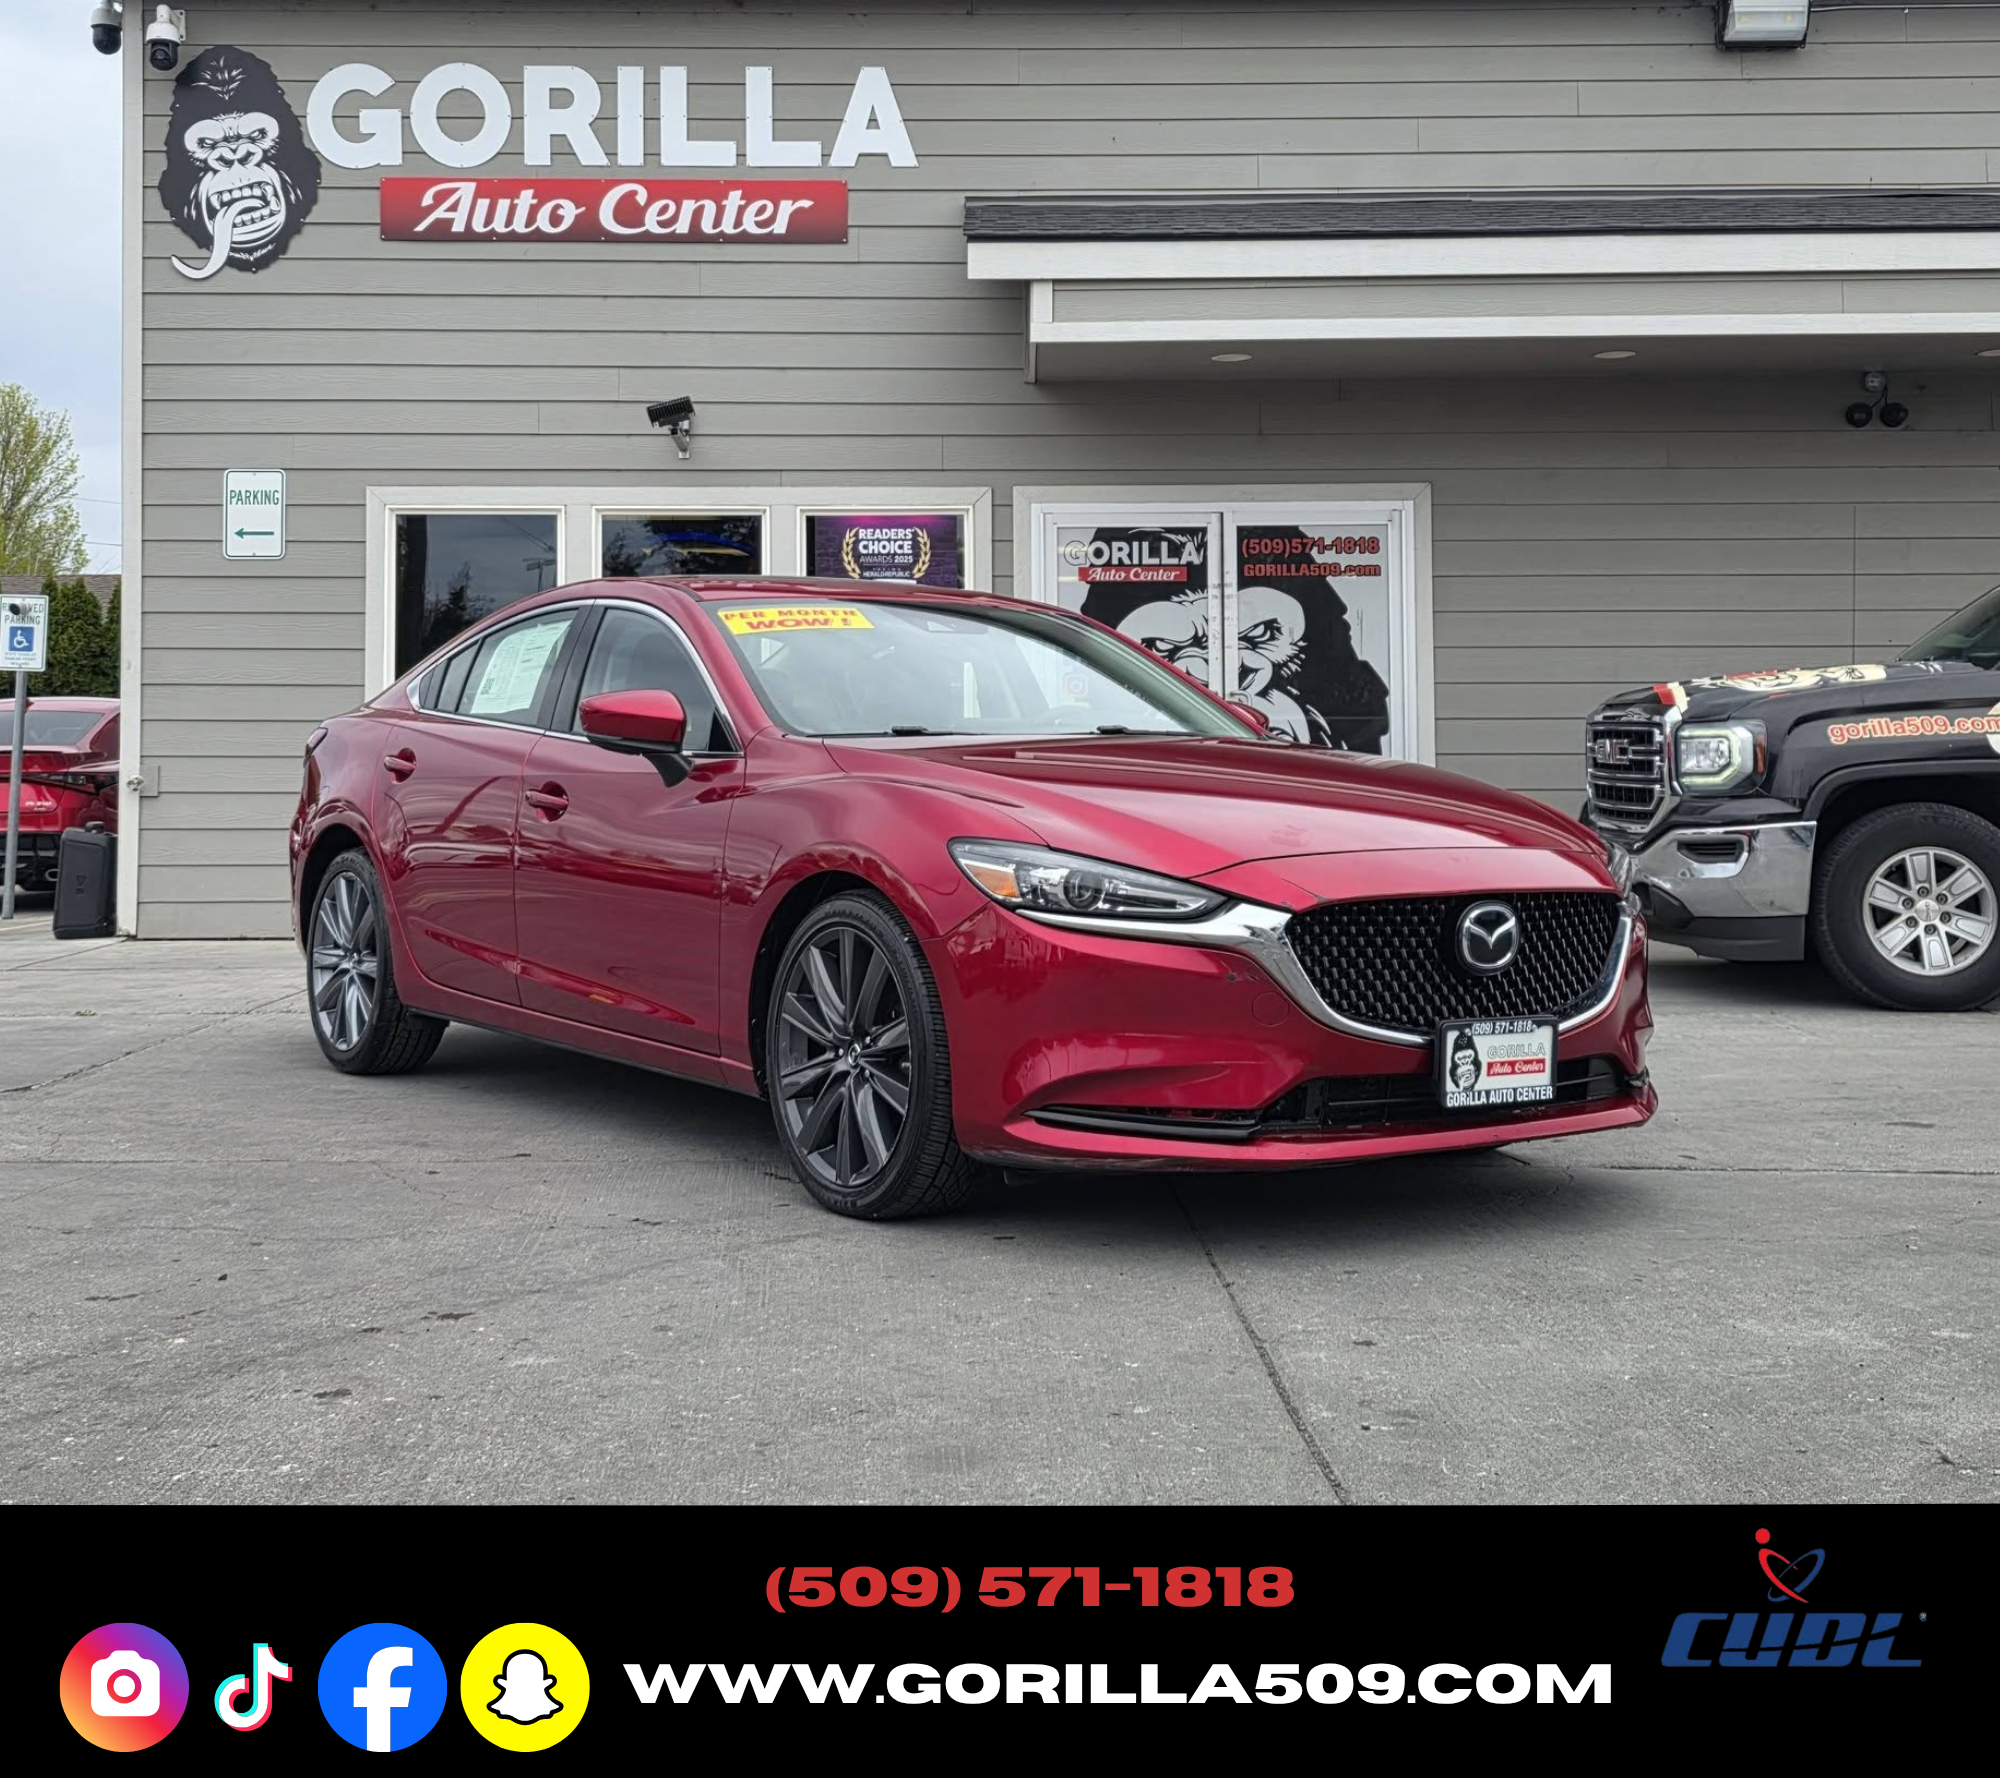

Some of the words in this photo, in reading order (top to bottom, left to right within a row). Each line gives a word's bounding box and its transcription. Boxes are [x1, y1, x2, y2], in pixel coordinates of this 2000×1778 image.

[307, 63, 918, 168] GORILLA
[413, 182, 586, 233] Auto
[599, 182, 815, 235] Center
[229, 489, 280, 506] PARKING
[858, 540, 912, 554] CHOICE
[1064, 540, 1201, 566] GORILLA
[1241, 536, 1381, 558] (509)571-1818
[859, 555, 893, 564] AWARDS
[894, 555, 913, 564] 2025
[1087, 567, 1127, 581] Auto
[1129, 567, 1181, 581] Center
[1243, 562, 1382, 577] GORILLA509.com
[4, 614, 41, 625] PARKING
[724, 611, 765, 620] PER
[778, 608, 858, 616] MONTH
[1472, 1021, 1493, 1035] (509)
[1487, 1043, 1546, 1060] GORILLA
[1446, 1090, 1487, 1107] GORILLA
[1489, 1088, 1514, 1104] AUTO
[1516, 1086, 1553, 1101] CENTER
